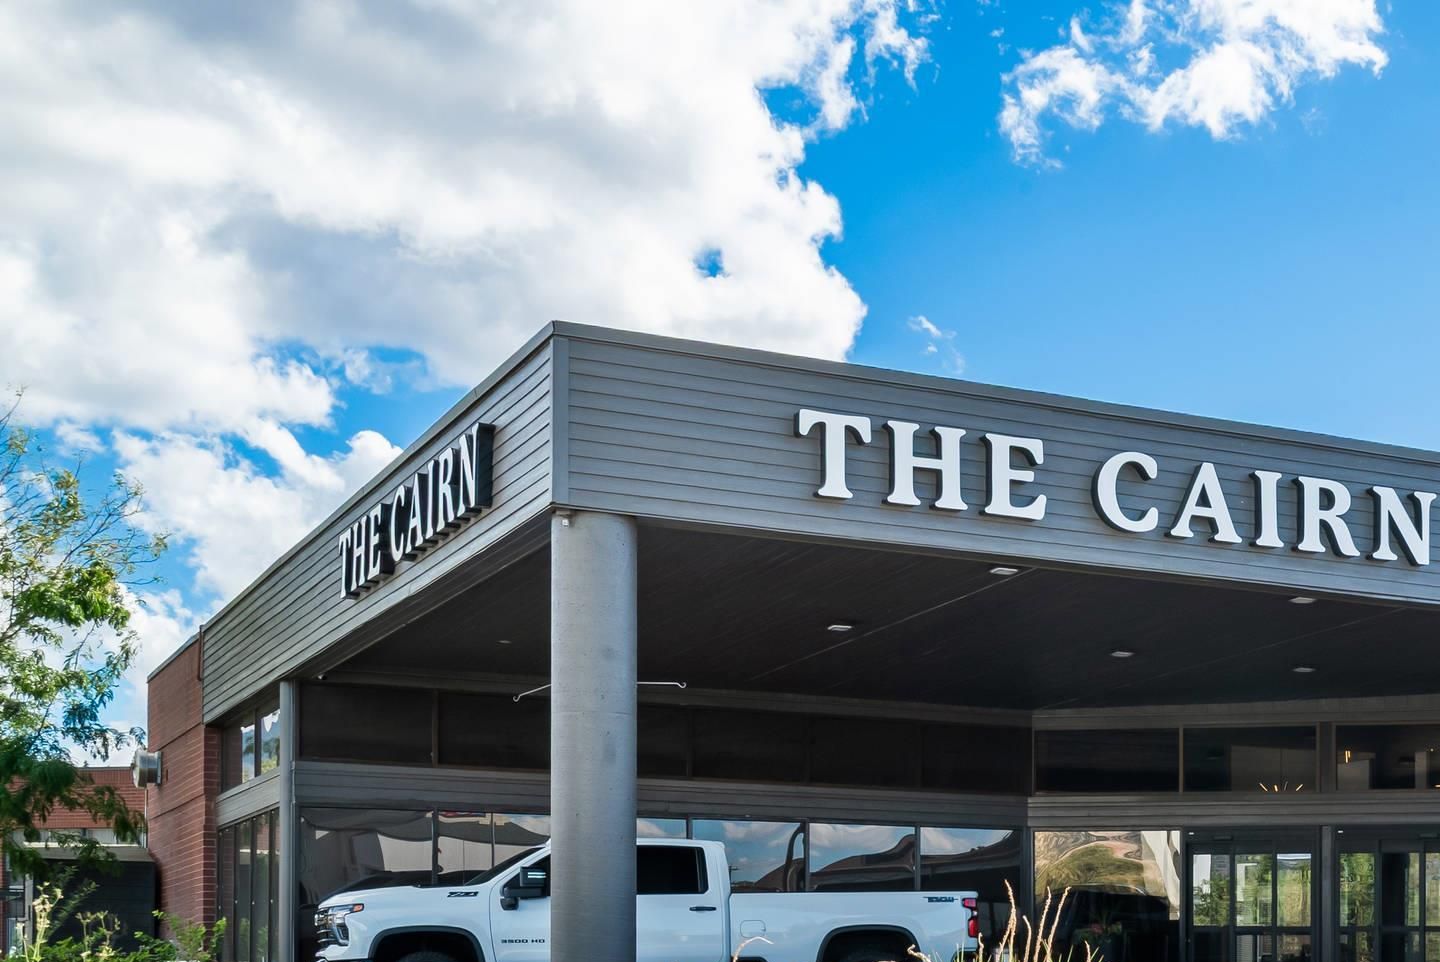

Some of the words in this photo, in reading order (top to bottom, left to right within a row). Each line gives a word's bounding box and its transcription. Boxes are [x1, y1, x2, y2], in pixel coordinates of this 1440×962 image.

[338, 503, 386, 599] THE
[390, 422, 485, 562] CAIRN
[797, 408, 1048, 521] THE
[1094, 450, 1438, 566] CAIRN
